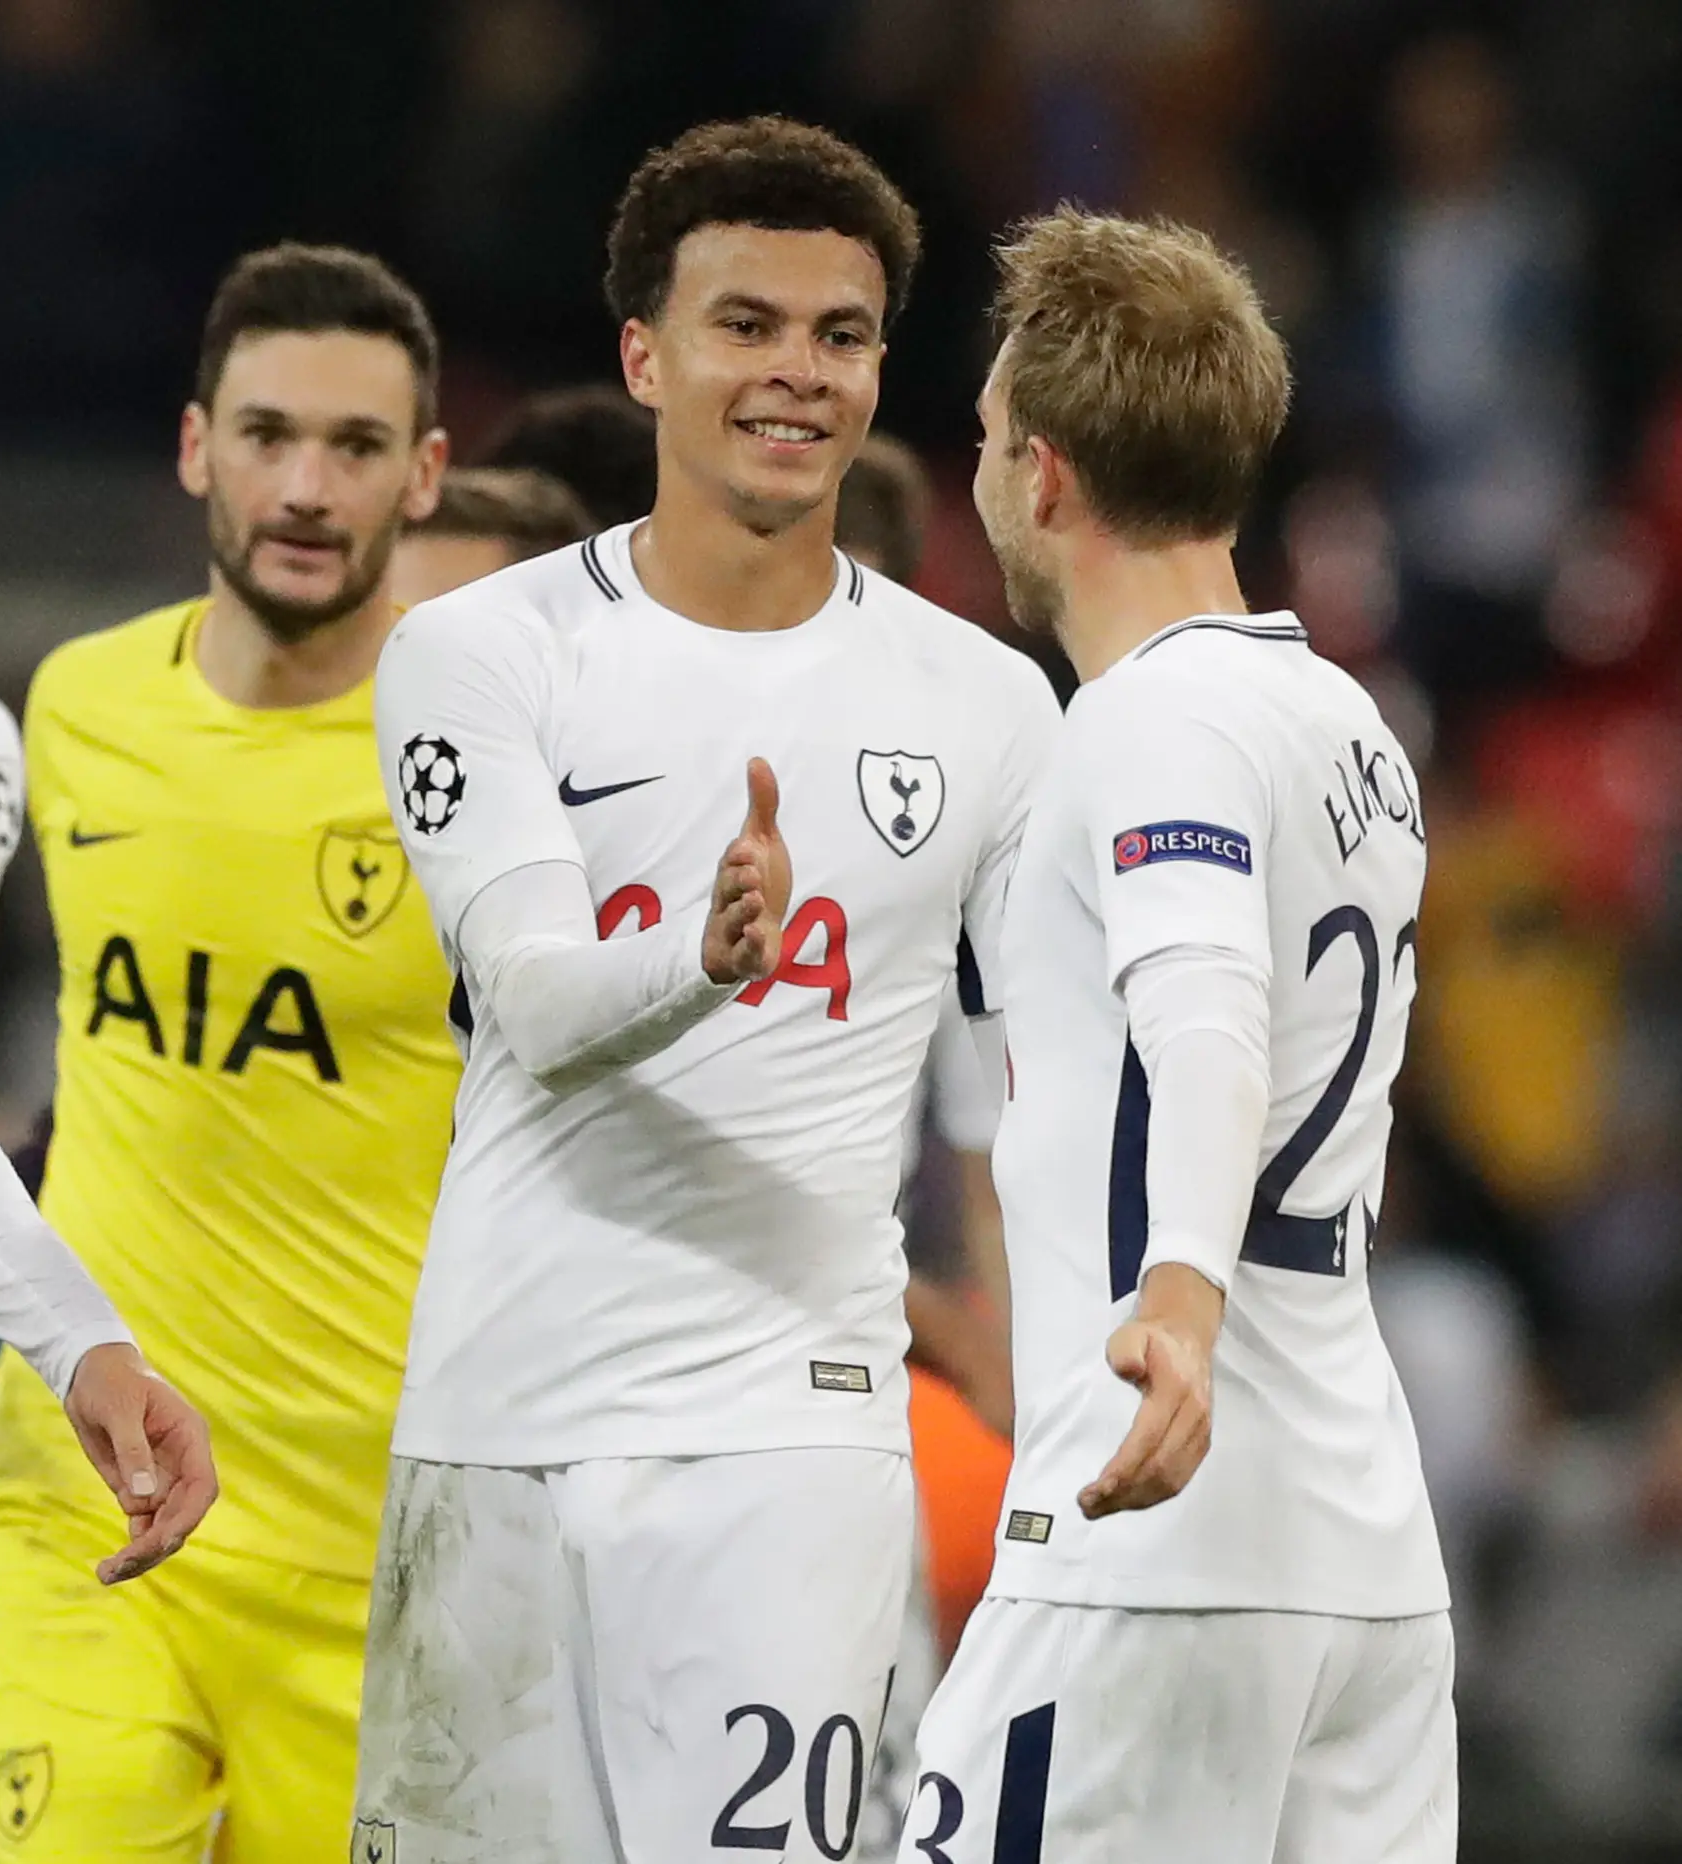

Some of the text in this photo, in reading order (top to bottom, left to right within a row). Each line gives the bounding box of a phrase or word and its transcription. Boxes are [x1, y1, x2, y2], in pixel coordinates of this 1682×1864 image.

[1150, 830, 1249, 864] RESPECT
[85, 934, 343, 1084] AIA
[711, 1703, 864, 1862] 20
